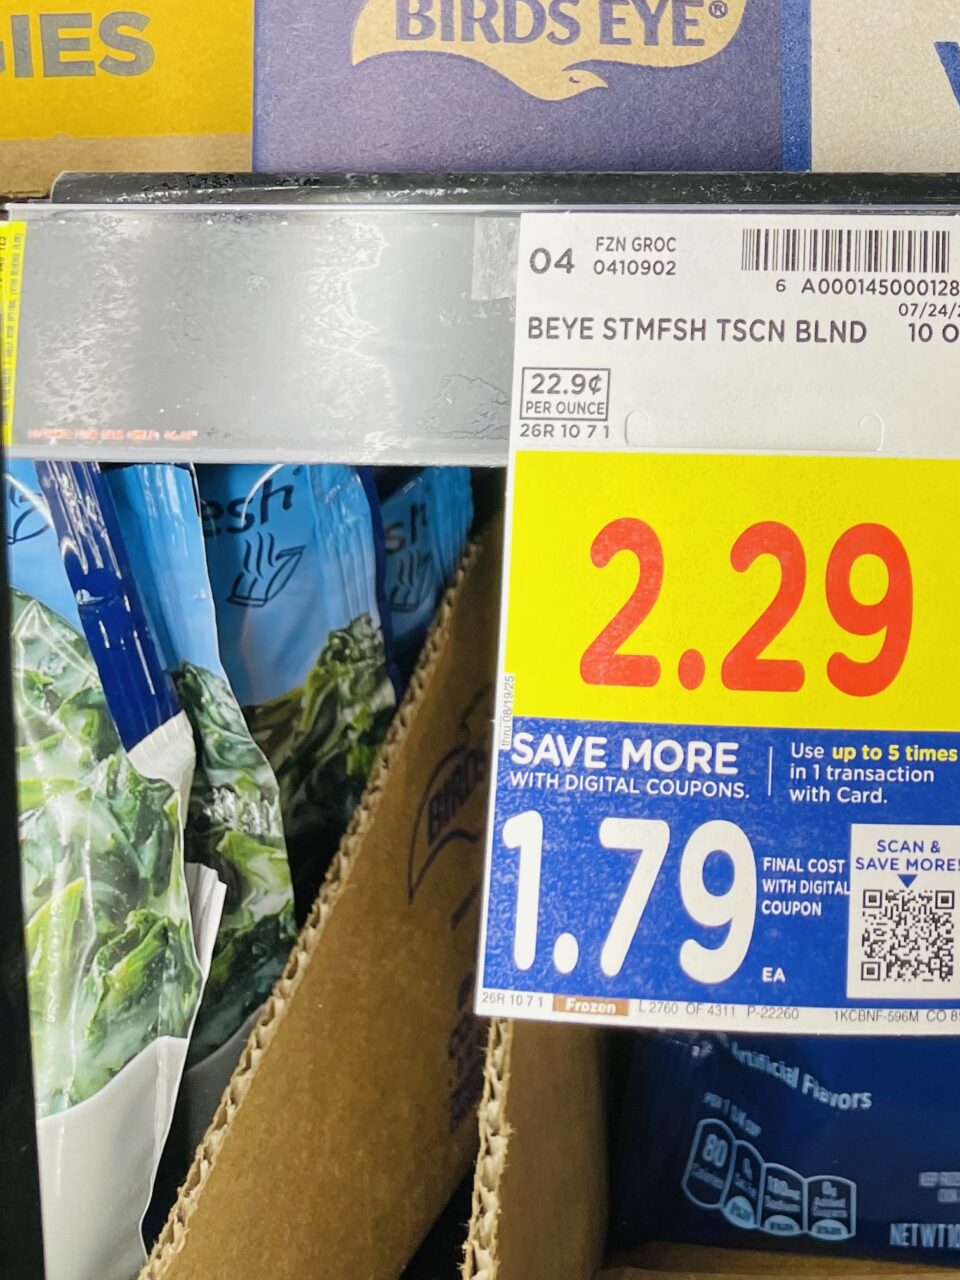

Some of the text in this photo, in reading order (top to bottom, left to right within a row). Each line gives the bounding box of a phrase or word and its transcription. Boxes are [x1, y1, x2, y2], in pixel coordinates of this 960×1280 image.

[0, 11, 156, 78] IES
[595, 236, 677, 253] FZN GROC
[528, 246, 576, 275] 04
[593, 259, 677, 276] 0410902
[775, 278, 787, 294] 6
[527, 316, 593, 341] BEYE
[602, 317, 707, 343] STMFSH
[717, 319, 785, 343] TSCN
[795, 320, 868, 344] BLND
[907, 322, 933, 344] 10
[530, 372, 603, 396] 22.9¢
[525, 400, 605, 415] PER OUNCE
[519, 423, 610, 440] 26R 10 7 1
[579, 516, 914, 698] 2.29
[511, 732, 739, 775] SAVE MORE
[790, 742, 959, 763] Use up to 5 times
[789, 763, 935, 782] in 1 transaction
[510, 771, 751, 799] WITH DIGITAL COUPONS.
[789, 786, 888, 804] with Card.
[876, 839, 941, 853] SCAN &
[762, 857, 846, 874] FINAL COST
[855, 857, 900, 871] SAVE
[761, 878, 851, 895] WITH DIGITAL
[502, 809, 757, 985] 1.79
[761, 899, 823, 917] COUPON
[762, 967, 786, 984] EA
[482, 992, 544, 1007] 26R 10 7 1
[565, 998, 617, 1014] Frozen
[648, 1001, 679, 1014] 2760
[685, 1001, 705, 1015] OF
[707, 1003, 736, 1017] 4311
[747, 1005, 800, 1020] P-22260
[926, 1009, 947, 1023] CO
